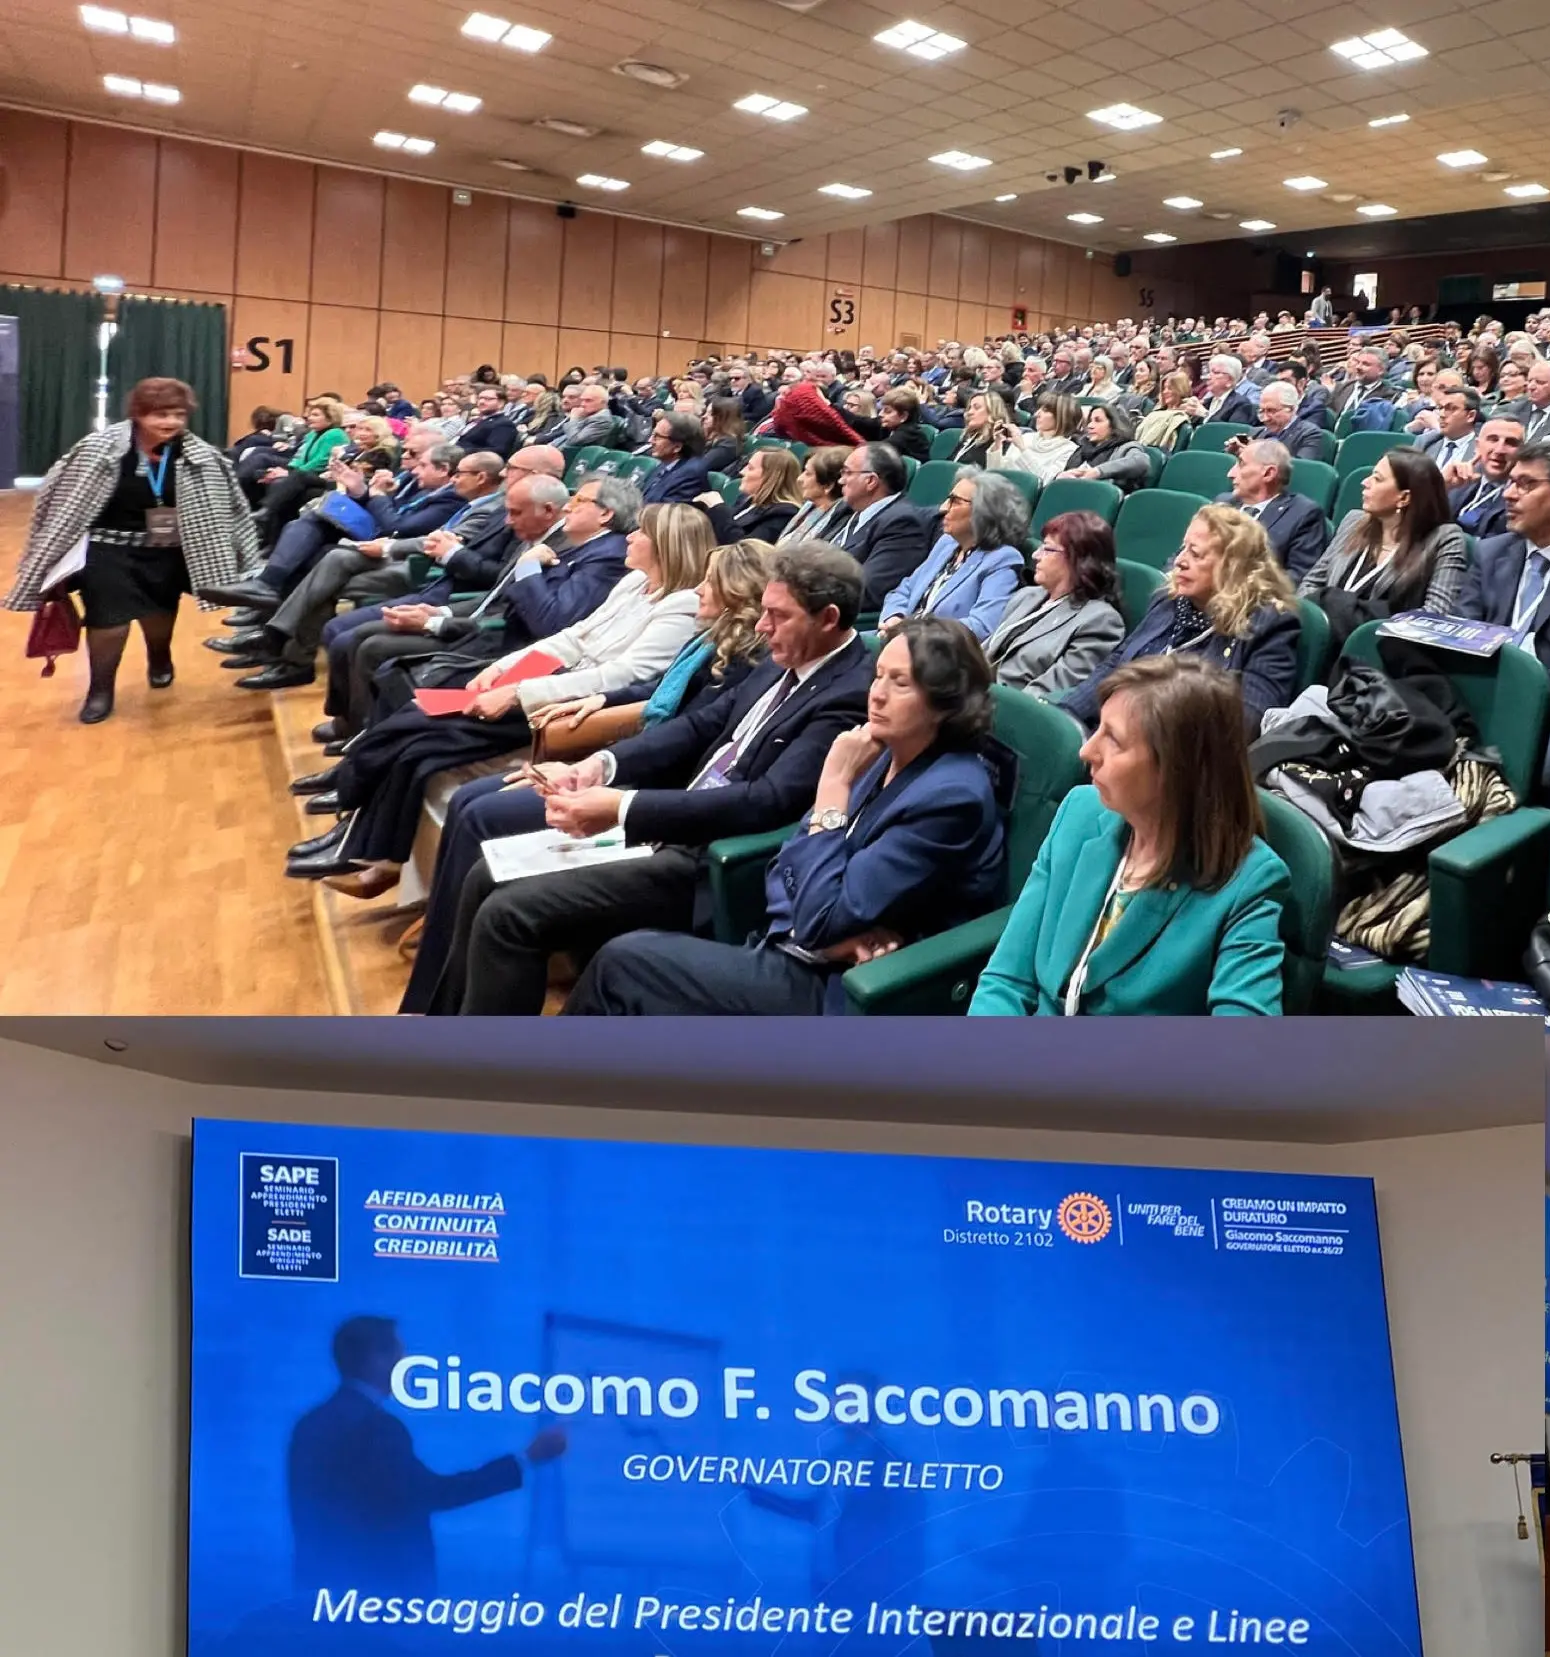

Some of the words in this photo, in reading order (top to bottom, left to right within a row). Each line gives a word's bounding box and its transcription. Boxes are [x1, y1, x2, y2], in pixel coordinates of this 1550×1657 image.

[830, 299, 854, 324] S3
[246, 336, 294, 374] S1
[260, 1165, 320, 1185] SAPE
[250, 1191, 328, 1203] APPRENDIMENTO
[263, 1185, 315, 1194] SEMINARIO
[263, 1200, 315, 1210] PRESIDENTI
[365, 1189, 505, 1211] AFFIDABILITÀ
[1222, 1197, 1276, 1212] CREIAMO
[1277, 1200, 1296, 1213] UN
[1297, 1201, 1347, 1215] IMPATTO
[274, 1208, 304, 1217] ELETTI
[966, 1200, 1053, 1230] Rotary
[1128, 1203, 1159, 1216] UNITI
[1160, 1205, 1182, 1216] PER
[374, 1213, 498, 1234] CONTINUITÀ
[1147, 1214, 1177, 1226] FARE
[1178, 1215, 1200, 1227] DEL
[1223, 1210, 1288, 1225] DURATURO
[267, 1228, 312, 1243] SADE
[943, 1229, 1010, 1246] Distretto
[1014, 1231, 1054, 1247] 2102
[1174, 1225, 1205, 1237] BENE
[1225, 1230, 1274, 1242] Giacomo
[1275, 1232, 1344, 1246] Saccomanno
[256, 1249, 322, 1260] APPRENDIMENTO
[267, 1243, 311, 1252] SEMINARIO
[374, 1237, 498, 1259] CREDIBILITÀ
[1226, 1242, 1283, 1253] GOVERNATORE
[1283, 1244, 1312, 1254] ELETTO
[269, 1257, 309, 1265] DIRIGENTI
[276, 1263, 302, 1271] ELETTI
[391, 1356, 699, 1418] Giacomo
[724, 1367, 770, 1420] F.
[794, 1369, 1220, 1435] Saccomanno
[623, 1454, 873, 1486] GOVERNATORE
[883, 1461, 1003, 1490] ELETTO
[312, 1588, 544, 1634] Messaggio
[558, 1593, 621, 1628] del
[634, 1596, 852, 1634] Presidente
[867, 1602, 1160, 1641] Internazionale
[1173, 1616, 1195, 1642] e
[1208, 1609, 1310, 1644] Linee
